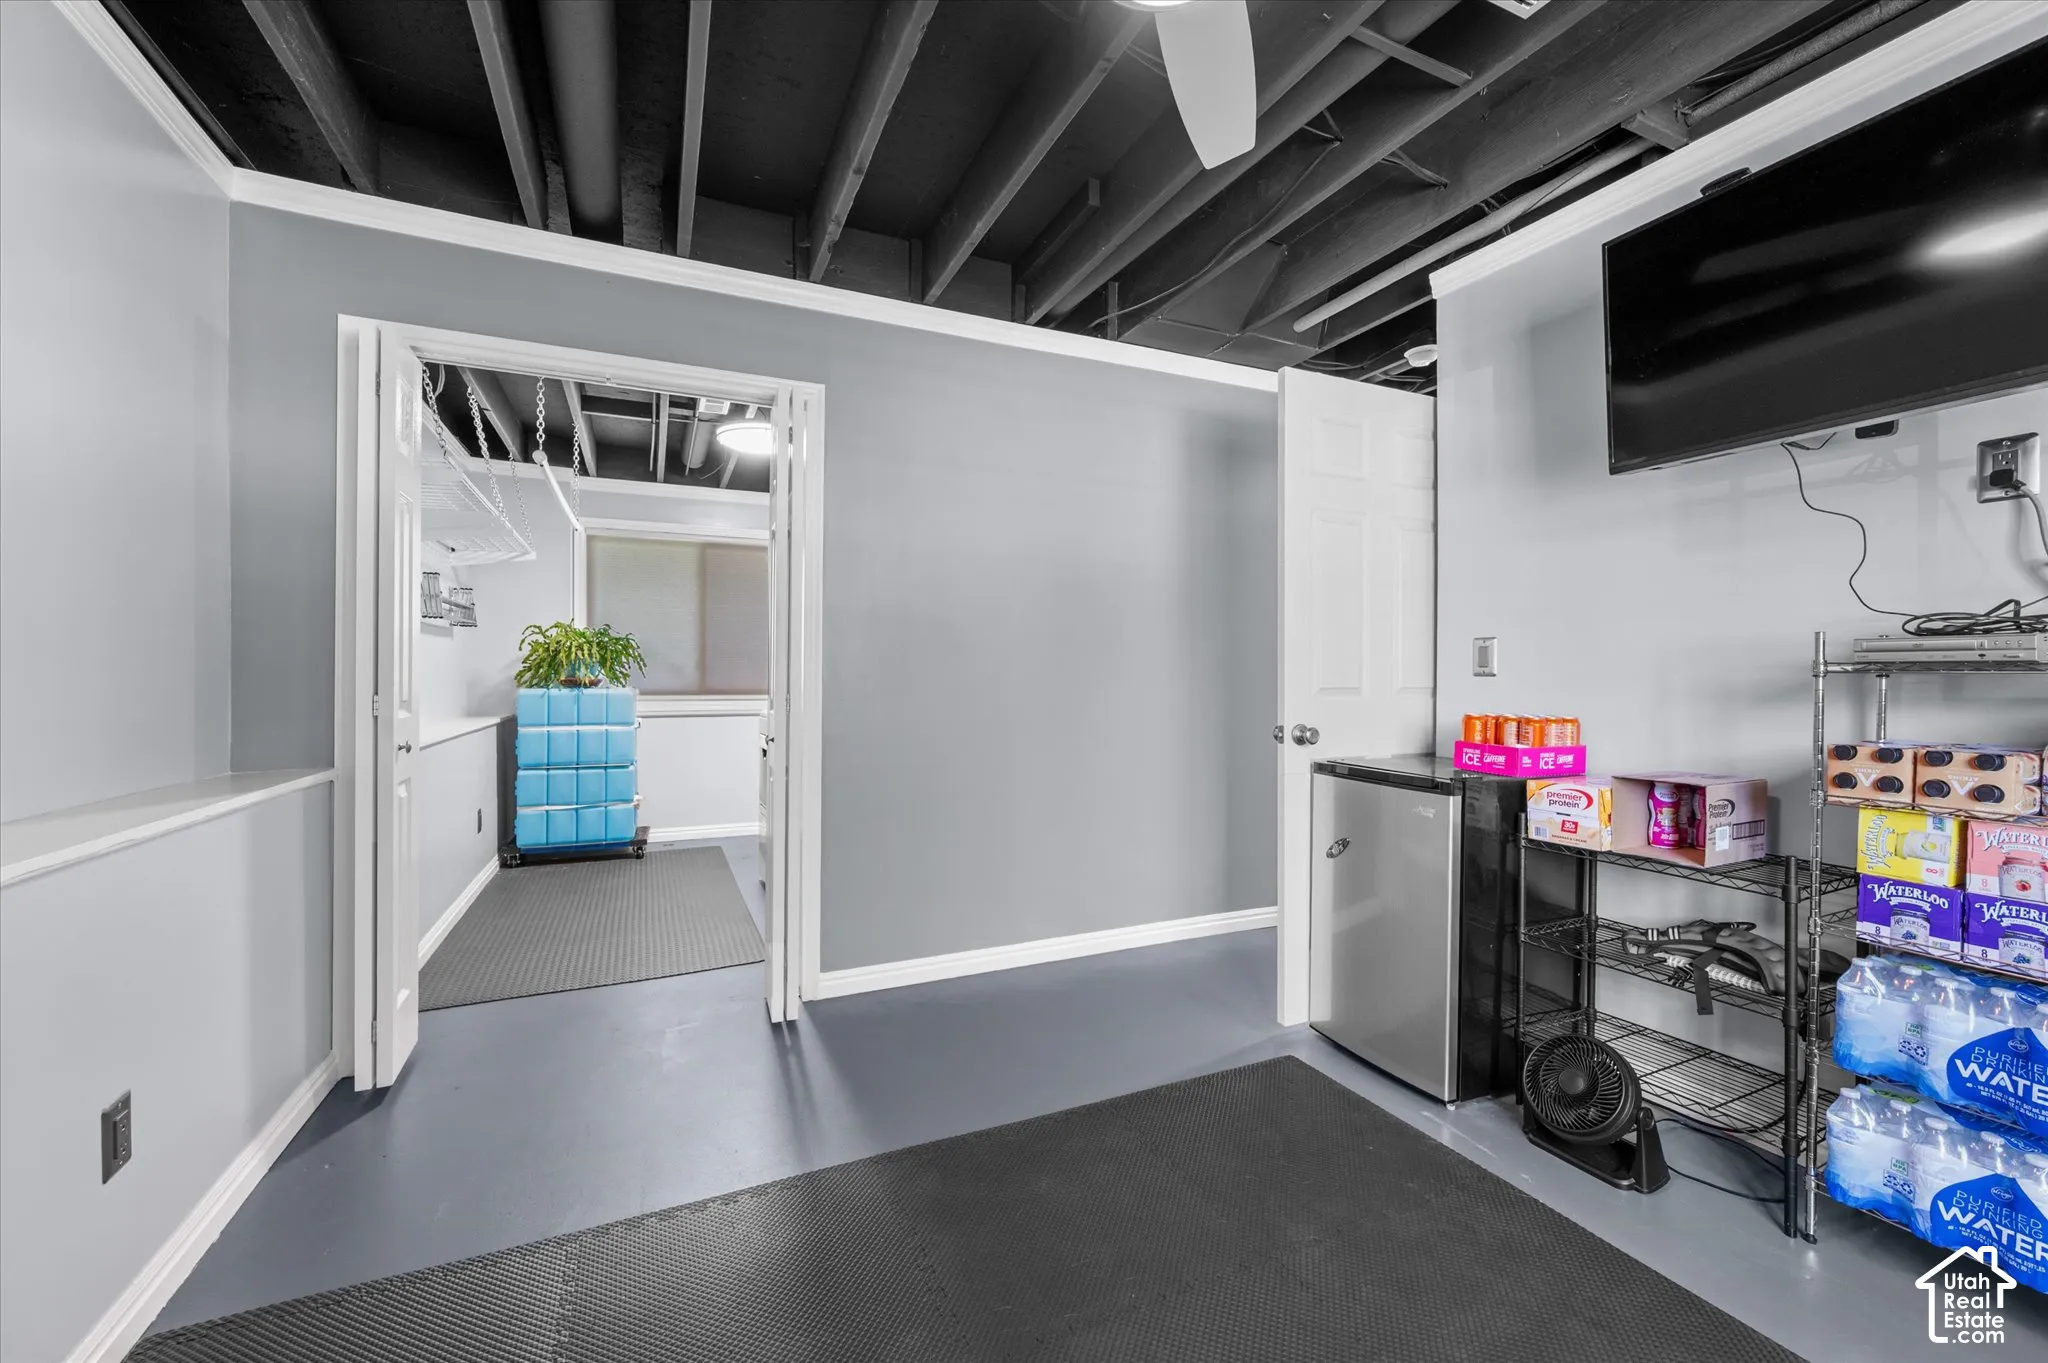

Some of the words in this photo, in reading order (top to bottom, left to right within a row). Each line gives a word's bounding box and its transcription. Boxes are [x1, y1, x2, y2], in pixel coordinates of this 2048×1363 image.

[1462, 753, 1482, 766] ICE
[1483, 754, 1506, 763] CAFFEINE
[1539, 757, 1555, 769] ICE
[1546, 791, 1583, 801] premier
[1548, 799, 1580, 809] protein
[1708, 802, 1729, 812] Premier
[1709, 810, 1728, 819] Protein
[1861, 814, 1892, 870] WATERLOO
[1981, 879, 1988, 887] 8
[1867, 881, 1949, 909] WATERLOO
[1875, 926, 1881, 935] 8
[1981, 949, 1988, 958] 8
[1974, 1046, 2048, 1076] PURIFIE
[1956, 1190, 2042, 1230] PURIFIED
[1953, 1197, 2043, 1239] DRINKING
[1937, 1200, 2048, 1262] WATER
